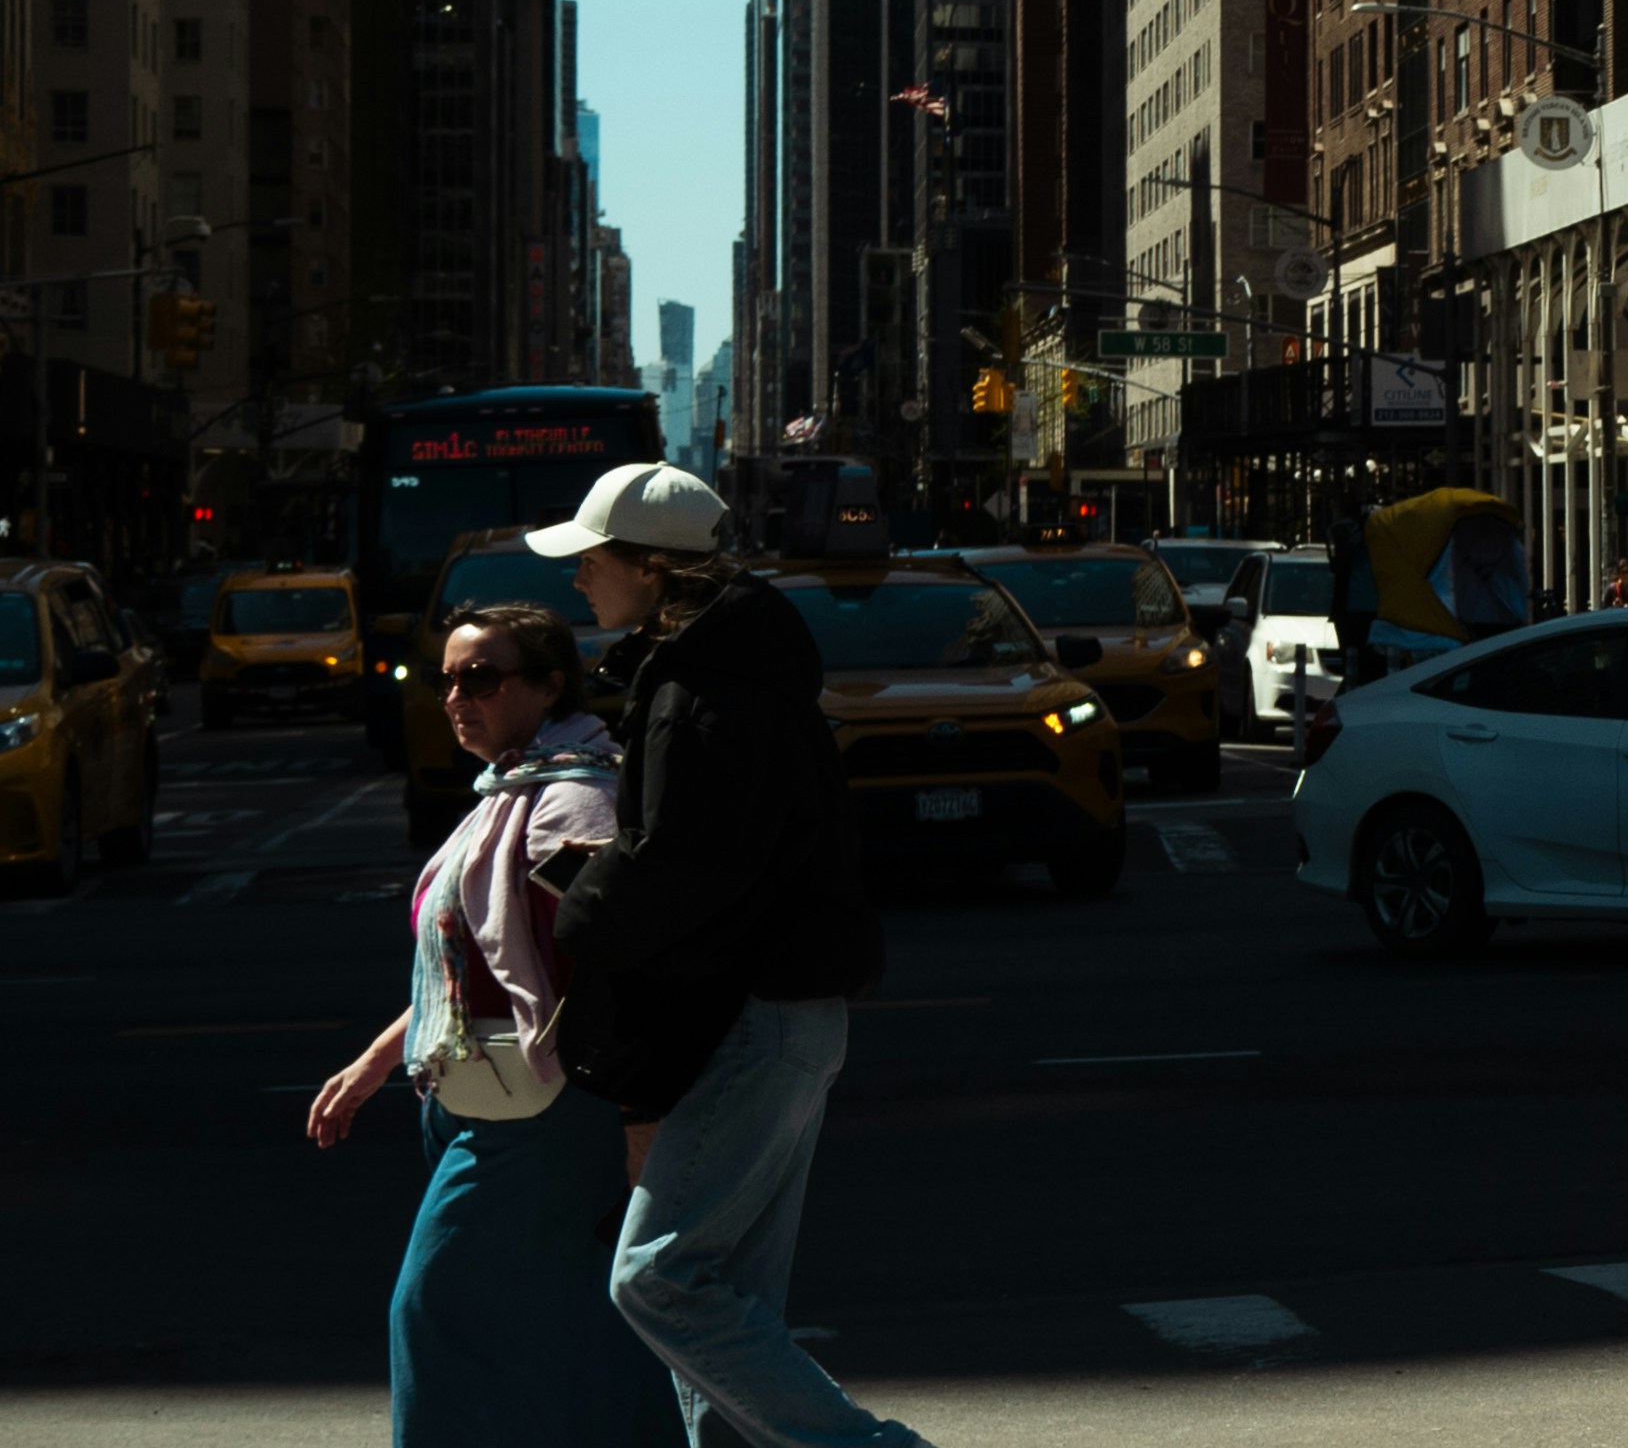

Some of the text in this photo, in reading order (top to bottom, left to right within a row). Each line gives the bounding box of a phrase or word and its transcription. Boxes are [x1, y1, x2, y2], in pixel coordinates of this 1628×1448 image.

[1133, 336, 1194, 353] W 58 St
[1383, 389, 1434, 401] CITILINE
